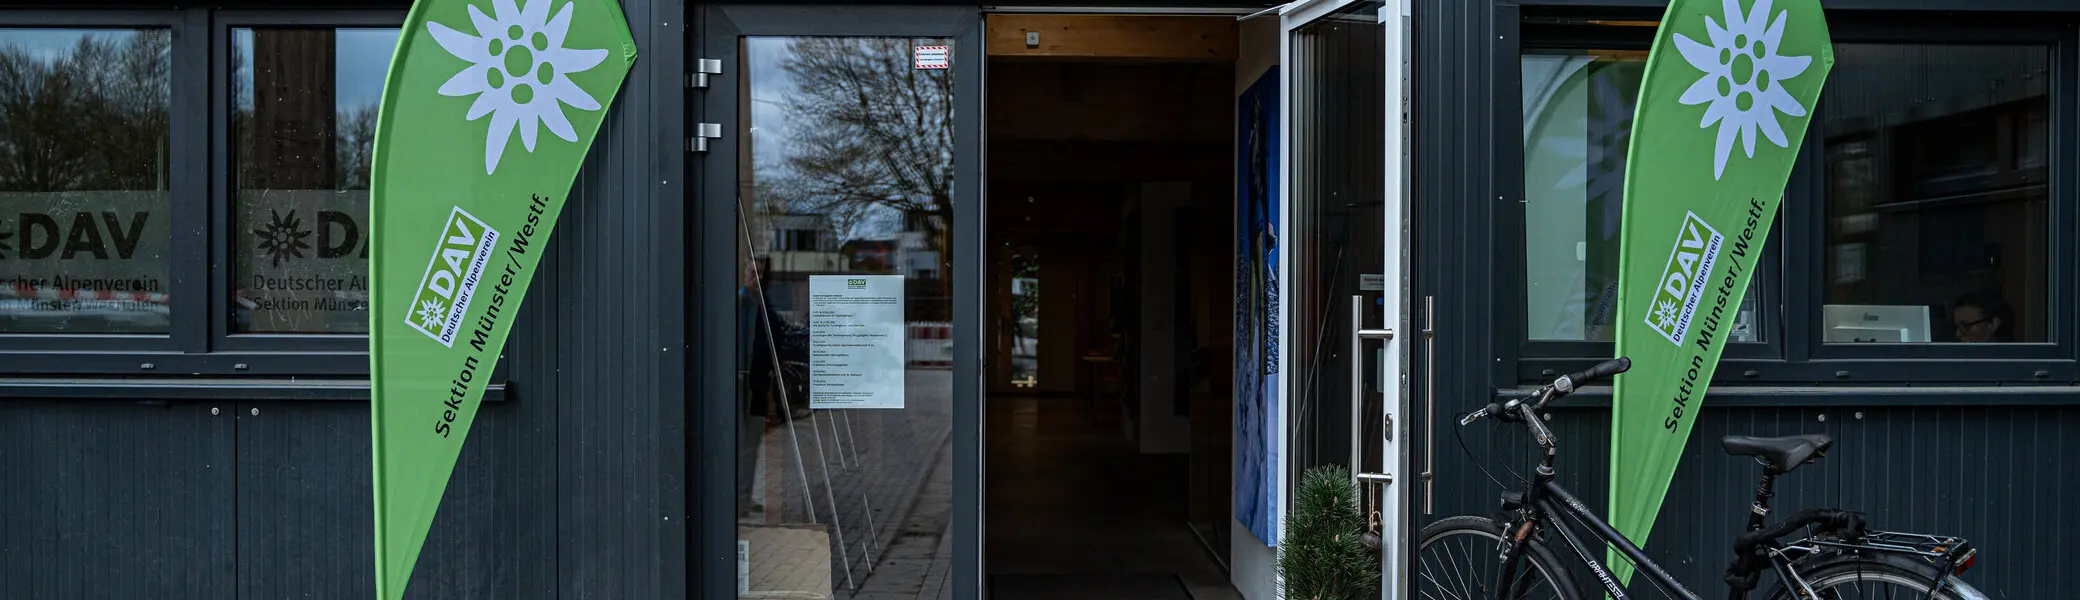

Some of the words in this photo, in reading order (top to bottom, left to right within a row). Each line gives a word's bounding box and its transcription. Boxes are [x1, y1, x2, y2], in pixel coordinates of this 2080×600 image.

[19, 211, 150, 260] DAV
[428, 217, 477, 300] DAV
[1664, 222, 1705, 301] DAV
[52, 273, 159, 296] Alpenverein
[253, 274, 344, 291] Deutscher
[254, 296, 309, 311] Sektion
[435, 355, 479, 438] Sektion
[469, 192, 549, 353] Münster/Westf.
[441, 291, 470, 343] Deutscher
[465, 231, 496, 291] Alpenverein
[1664, 355, 1704, 434] Sektion
[1697, 197, 1767, 352] Münster/Westf.
[1673, 294, 1698, 343] Deutscher
[1694, 235, 1721, 293] Alpenverein
